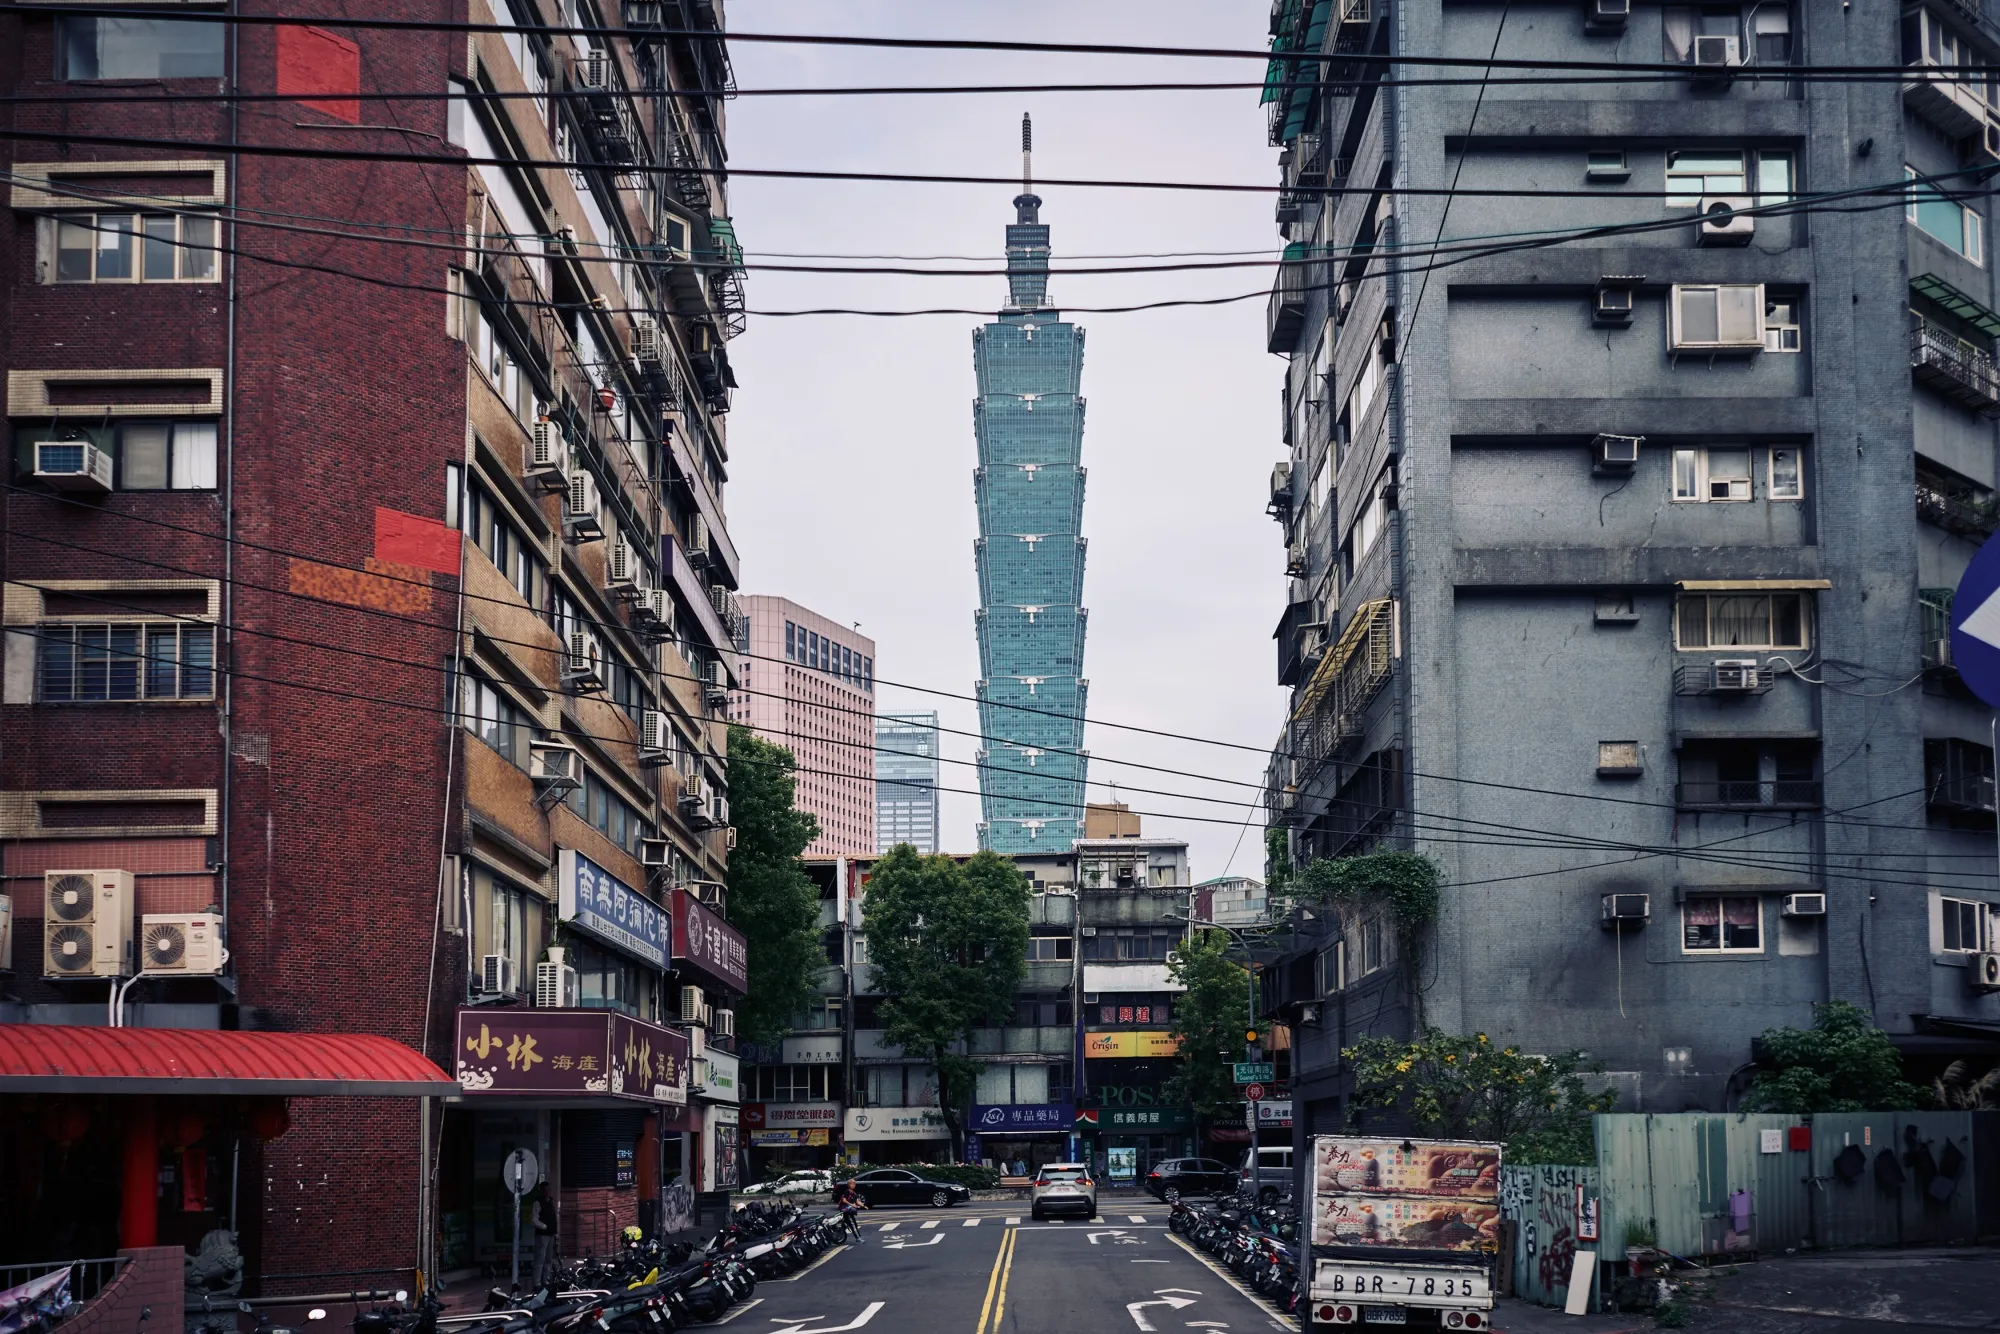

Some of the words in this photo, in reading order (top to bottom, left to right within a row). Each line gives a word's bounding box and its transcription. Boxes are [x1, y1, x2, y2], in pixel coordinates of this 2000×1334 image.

[578, 860, 668, 951] 南無阿彌陀佛
[466, 1023, 544, 1072] 小林
[551, 1053, 600, 1071] 海產
[1092, 1041, 1119, 1051] Origin
[624, 1024, 652, 1092] 小林
[656, 1051, 675, 1083] 海產
[1240, 1066, 1269, 1074] 光復南路
[1250, 1087, 1260, 1097] 停
[770, 1109, 836, 1120] 得恩堂眼鏡
[1012, 1109, 1059, 1121] 專品藥局
[1114, 1112, 1160, 1123] 信義房屋
[1274, 1109, 1292, 1117] 元健
